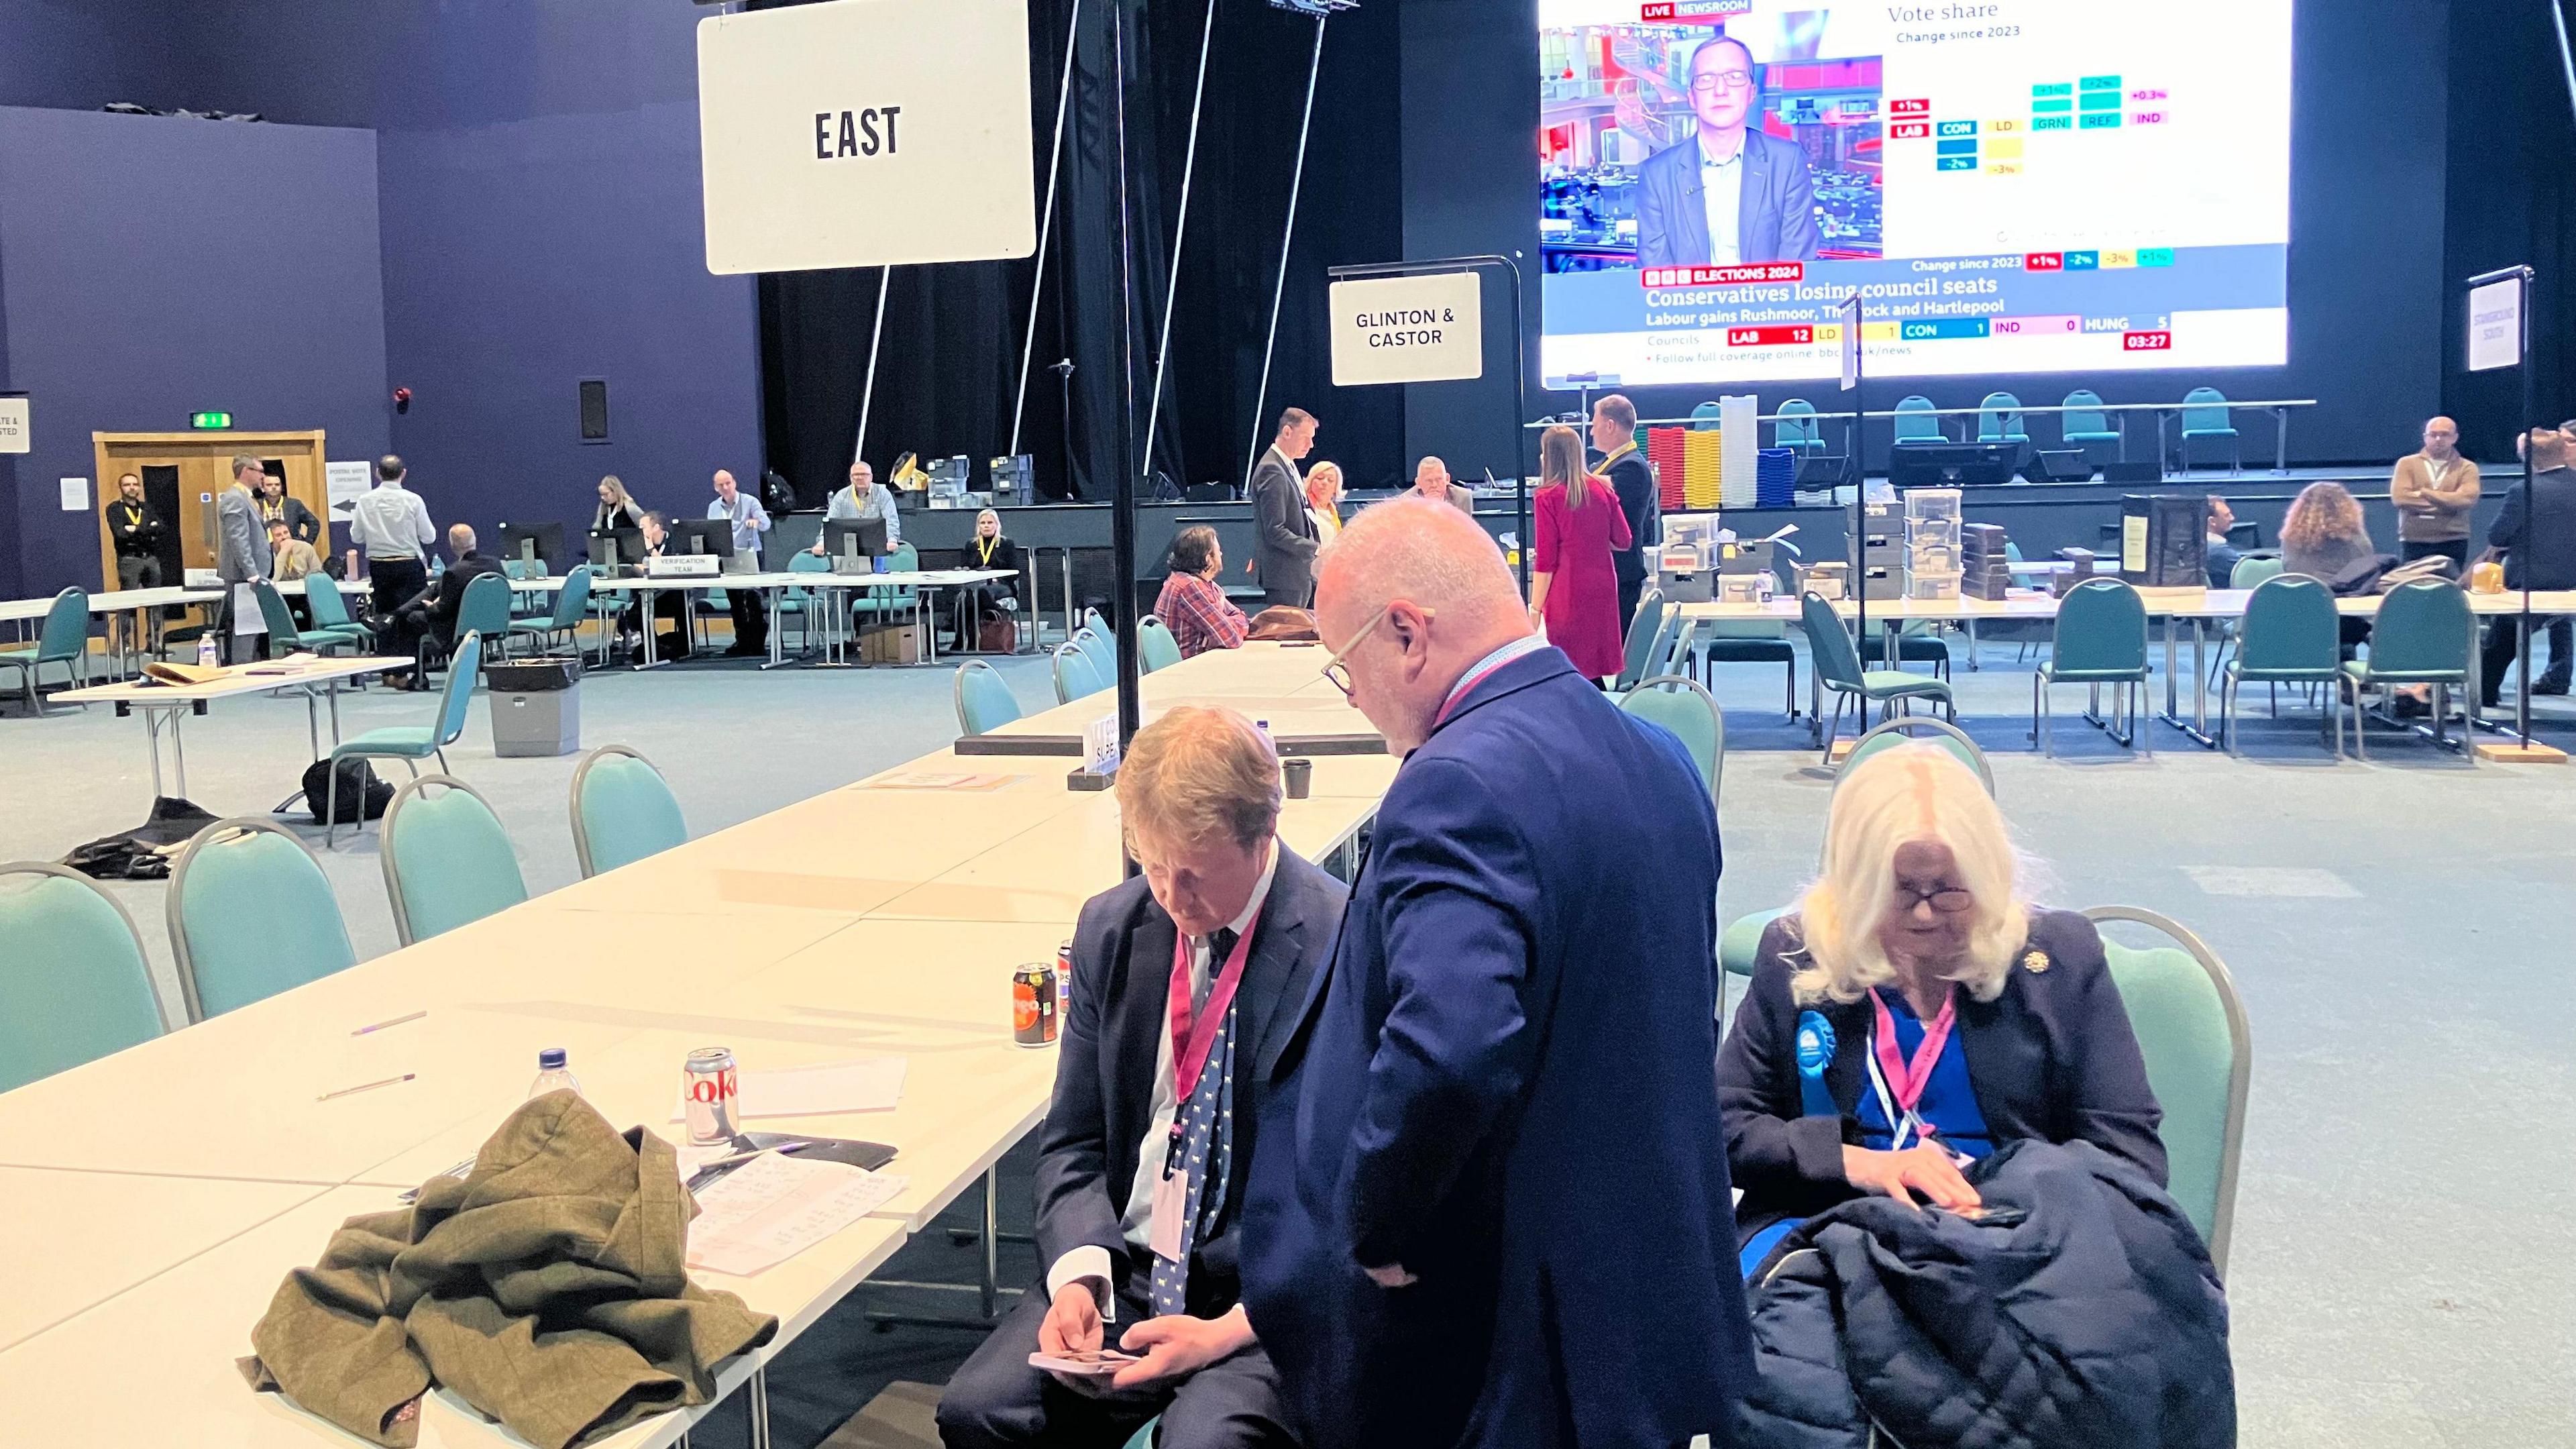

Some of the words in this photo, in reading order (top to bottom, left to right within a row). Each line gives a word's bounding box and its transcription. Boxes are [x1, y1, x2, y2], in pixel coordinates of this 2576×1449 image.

[1645, 5, 1670, 17] LIVE
[1678, 1, 1748, 14] NEWSROOM
[1888, 7, 1935, 22] Vote
[1941, 3, 1998, 20] share
[1896, 32, 1945, 44] Change
[1950, 30, 1983, 40] since
[1988, 25, 2021, 38] 2023
[2038, 118, 2066, 129] GRN
[2089, 116, 2112, 126] REF
[2137, 113, 2161, 123] IND
[816, 106, 901, 160] EAST
[1896, 125, 1924, 138] LAB
[1942, 122, 1972, 135] CON
[1996, 121, 2012, 131] LD
[1947, 158, 1969, 169] -2%
[1994, 165, 2015, 174] -3%
[1912, 260, 1957, 274] Change
[1959, 258, 1990, 270] since
[1992, 256, 2023, 268] 2023
[2069, 254, 2093, 265] -2%
[2106, 253, 2129, 263] -3%
[1694, 267, 1766, 282] ELECTIONS
[1768, 266, 1800, 279] 2024
[1646, 286, 1790, 307] Conservatives
[1794, 282, 1857, 301] losing
[1862, 277, 1938, 299] council
[1943, 276, 1998, 295] seats
[1356, 309, 1436, 327] GLINTON
[1443, 308, 1454, 323] &
[1646, 312, 1697, 327] Labour
[1699, 309, 1737, 327] gains
[1741, 307, 1819, 323] Rushmoor,
[1892, 302, 1921, 316] and
[1923, 299, 2004, 317] Hartlepool
[1905, 324, 1937, 337] CON
[1977, 323, 1984, 334] 1
[1996, 322, 2021, 333] IND
[2067, 321, 2075, 331] 0
[2085, 317, 2129, 331] HUNG
[2157, 316, 2168, 329] 5
[1369, 329, 1442, 347] CASTOR
[1648, 335, 1700, 347] Councils
[1731, 331, 1760, 344] LAB
[1792, 329, 1809, 342] 12
[1819, 329, 1836, 339] LD
[2127, 335, 2167, 349] 03:27
[1656, 354, 1694, 364] Follow
[1697, 352, 1717, 362] full
[1720, 350, 1773, 363] coverage
[1776, 349, 1812, 359] online
[13, 417, 17, 425] &
